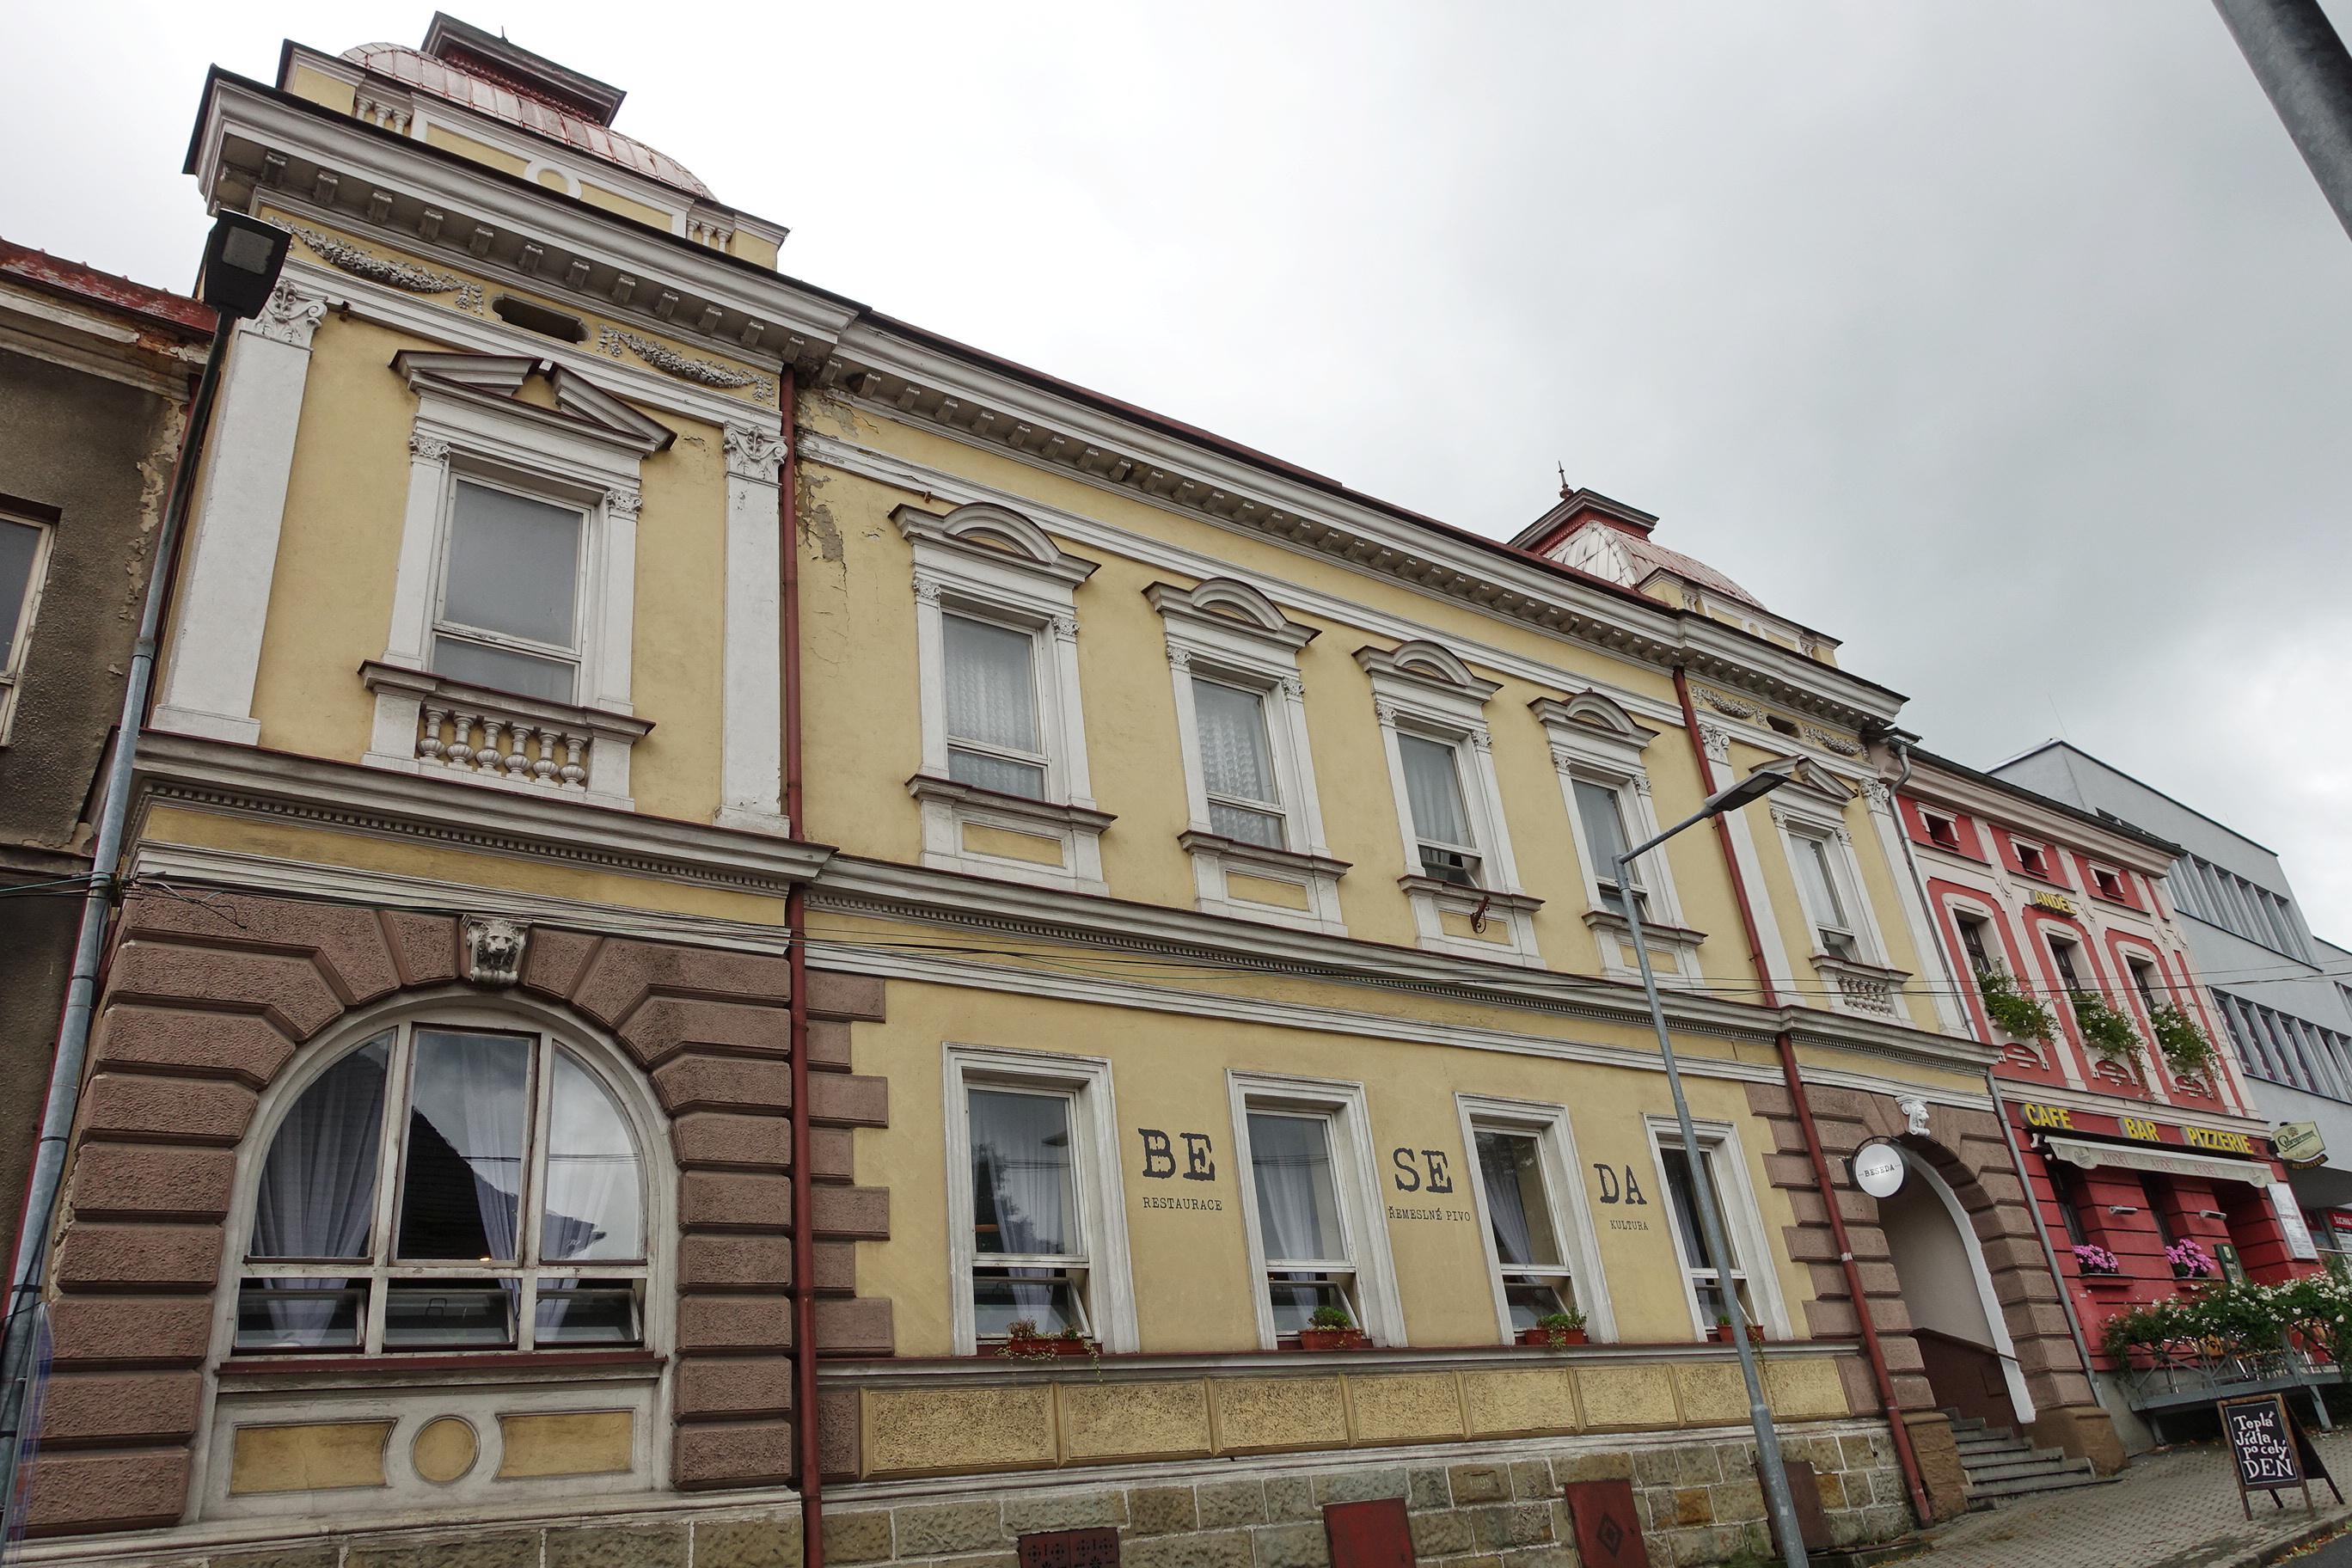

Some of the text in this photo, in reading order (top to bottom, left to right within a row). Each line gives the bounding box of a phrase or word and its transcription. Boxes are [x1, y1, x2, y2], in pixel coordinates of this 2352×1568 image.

[2024, 1103, 2255, 1155] CAFE BAR PIZZERIE
[1137, 1127, 1216, 1182] BE
[1393, 1147, 1454, 1194] SE
[1864, 1163, 1896, 1178] BESEDA
[1593, 1163, 1648, 1204] DA
[1142, 1197, 1222, 1210] RESTAURACE
[1387, 1205, 1471, 1222] ŘEMESLNÉ PIVO
[1610, 1220, 1649, 1231] KULTURA
[2233, 1411, 2275, 1432] Teplá
[2235, 1430, 2272, 1446] Jídla
[2242, 1439, 2288, 1461] po celý
[2243, 1458, 2294, 1479] DEN
